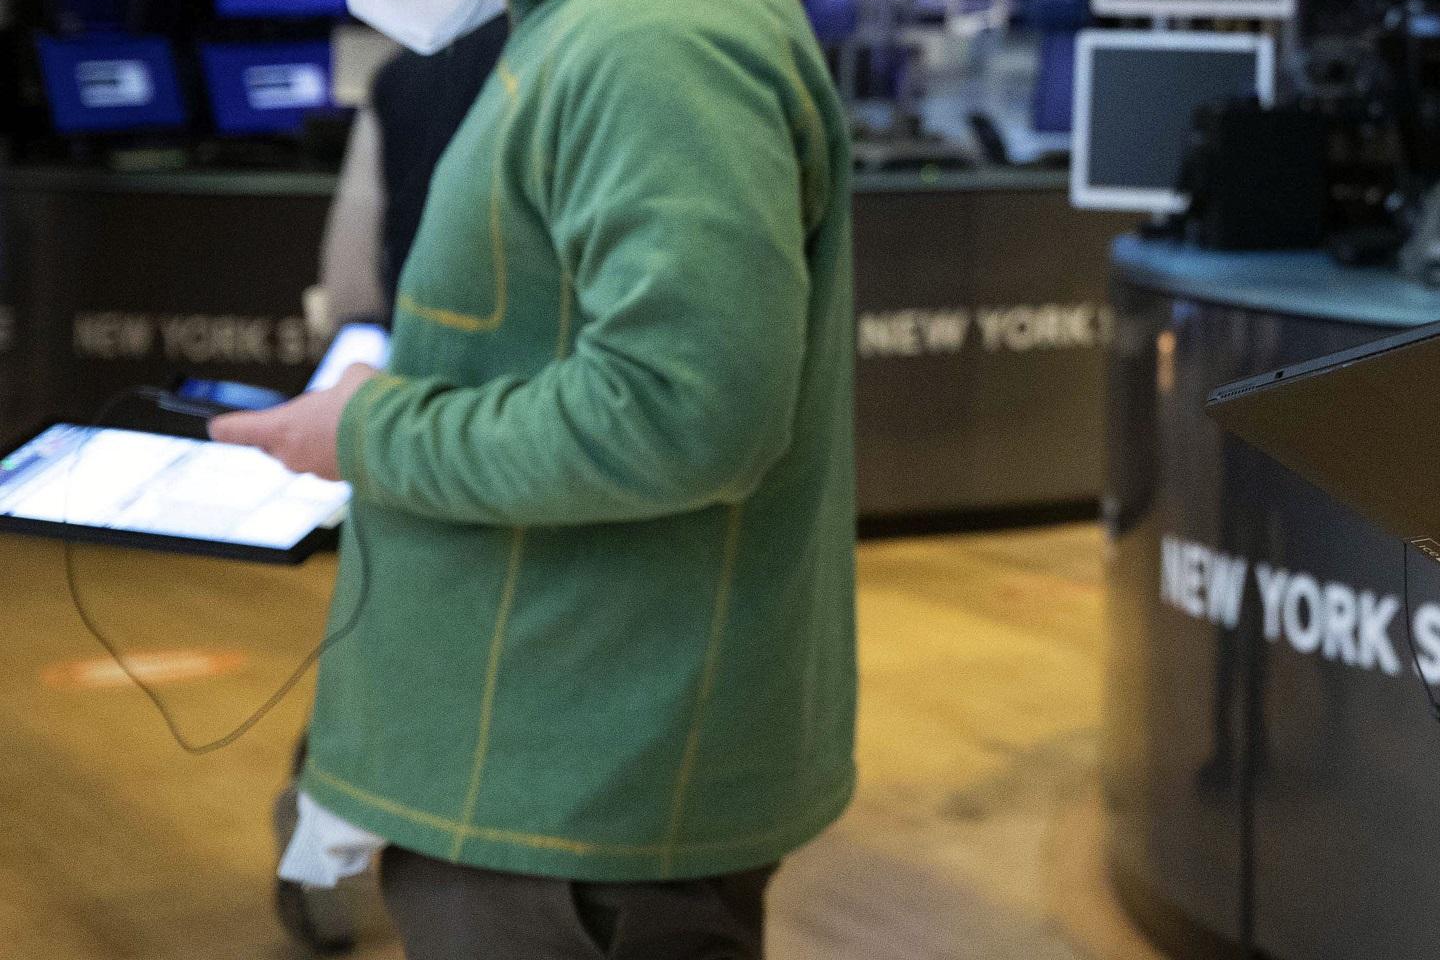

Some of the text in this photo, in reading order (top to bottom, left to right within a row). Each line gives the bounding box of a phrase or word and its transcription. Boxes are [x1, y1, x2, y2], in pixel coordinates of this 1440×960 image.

[159, 313, 273, 363] YORK
[858, 308, 969, 357] NEW
[976, 302, 1098, 351] YORK
[1161, 536, 1248, 629] NEW
[1254, 560, 1401, 677] YORK
